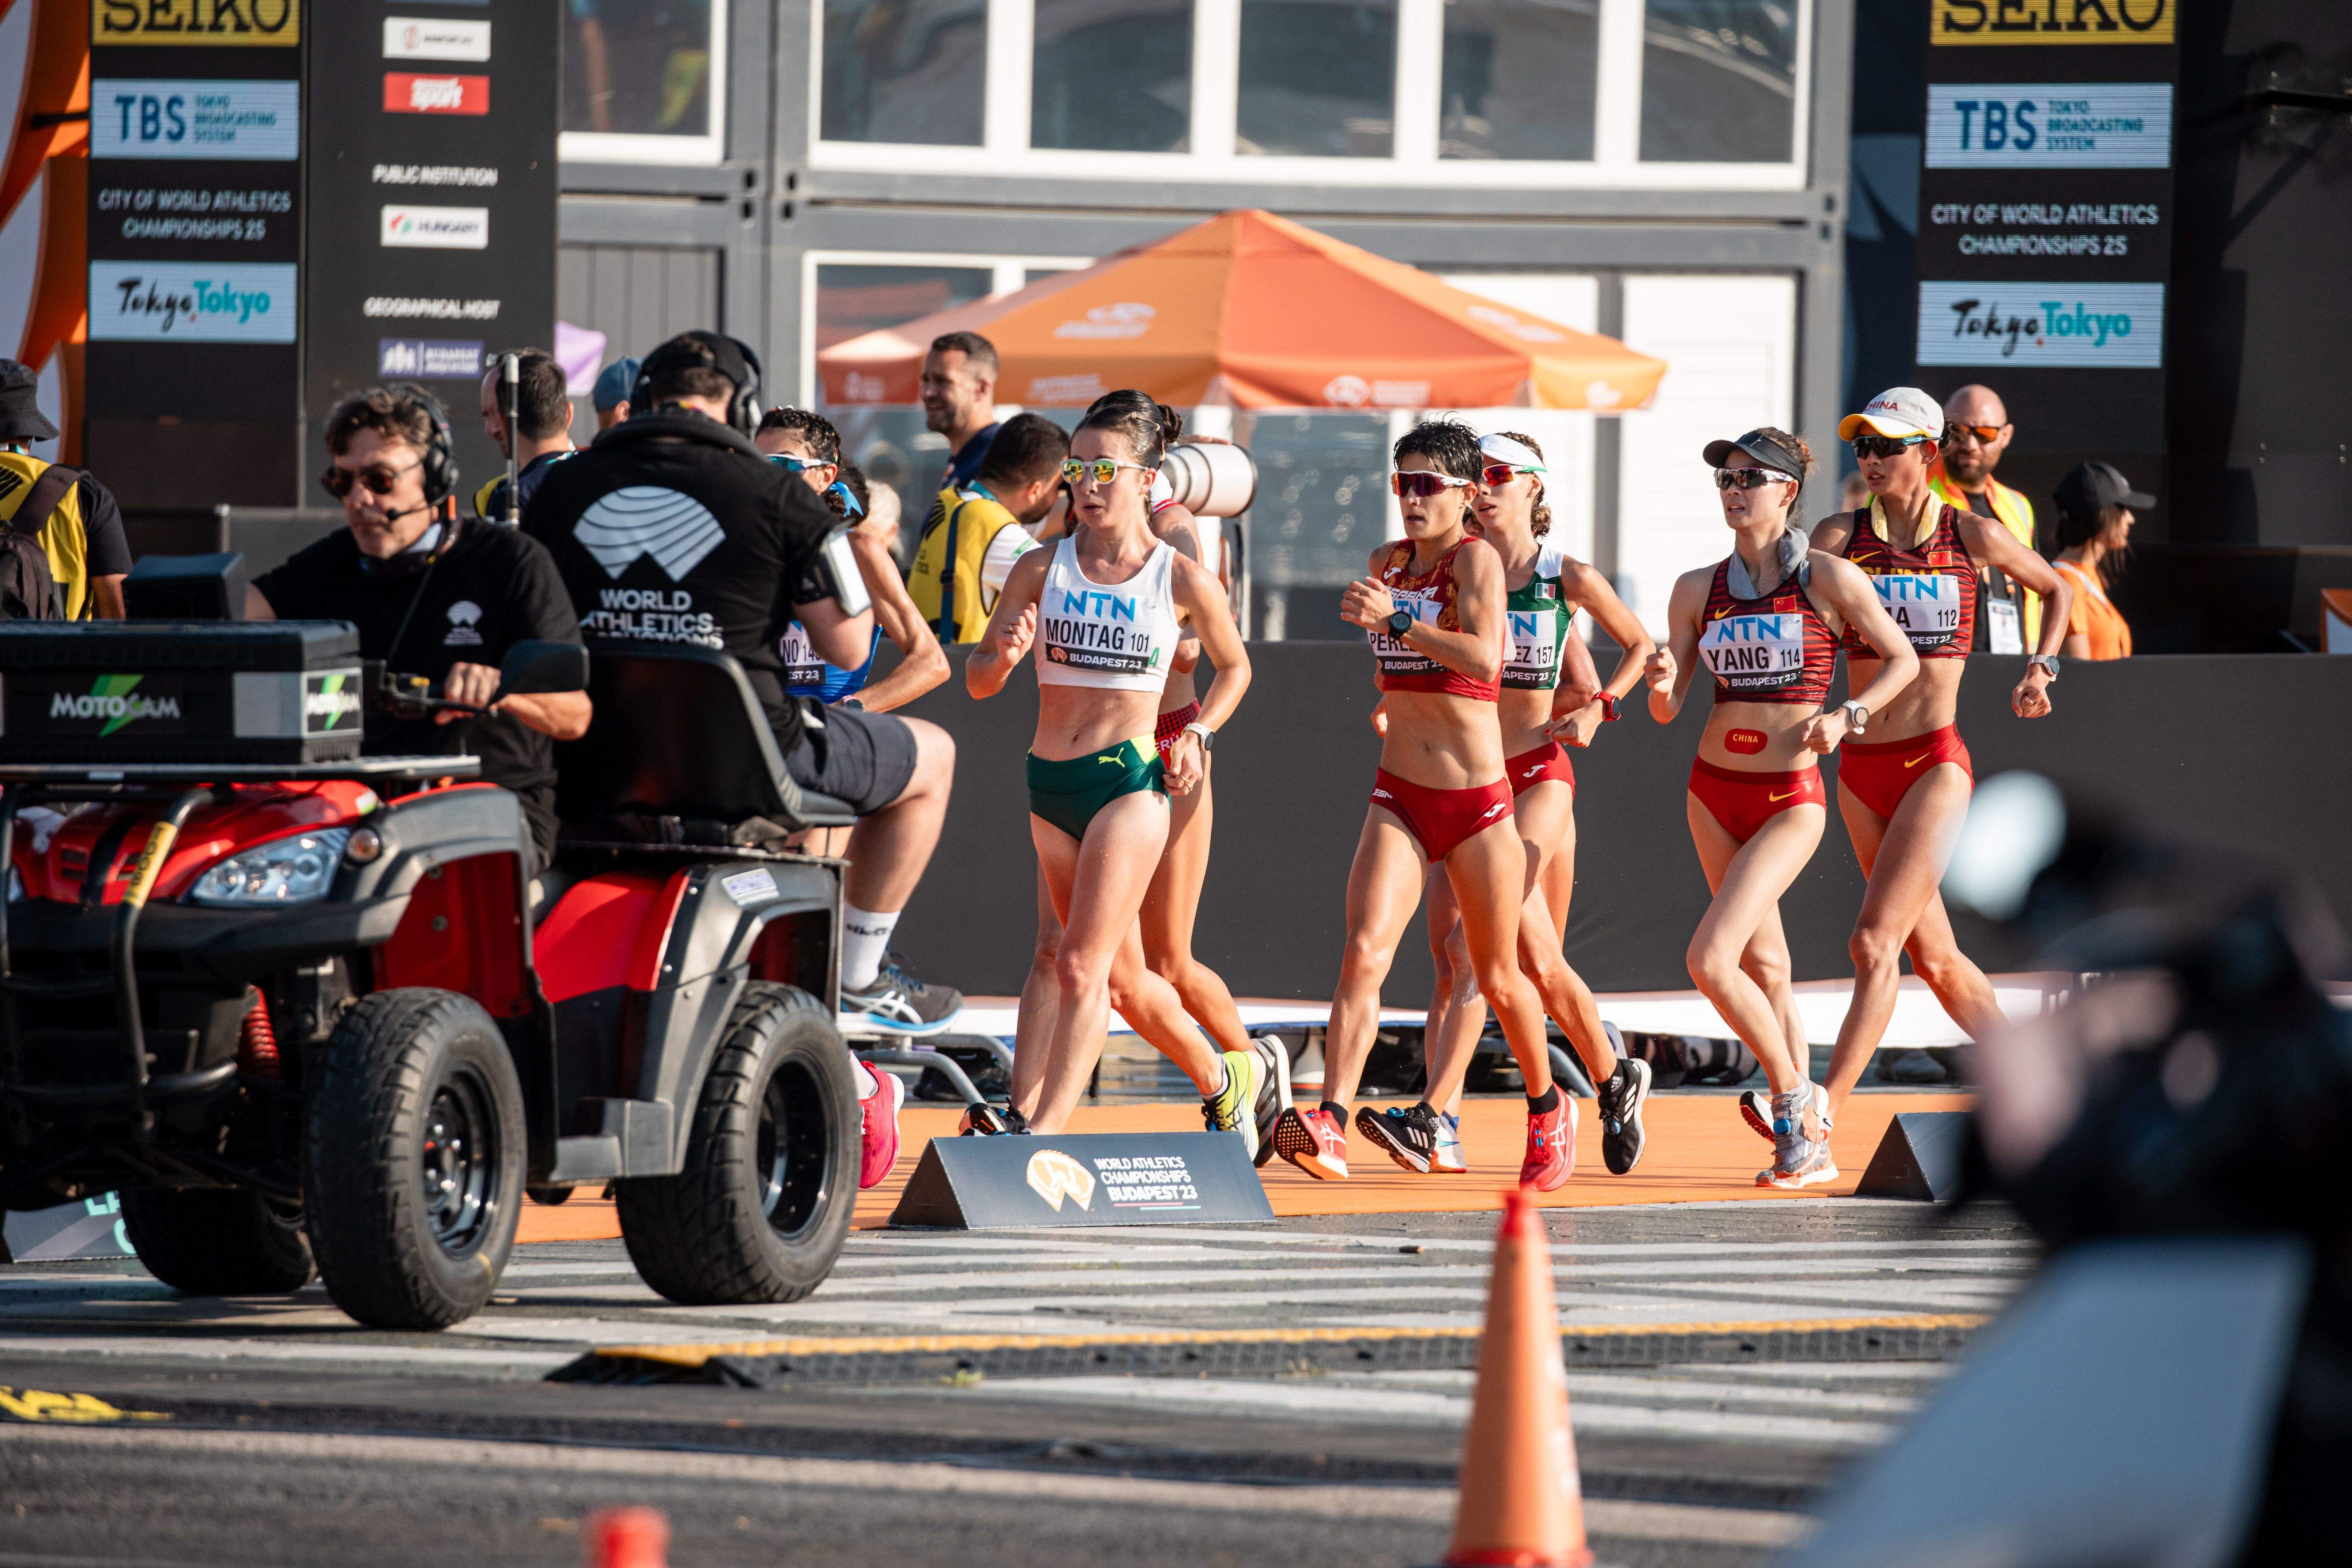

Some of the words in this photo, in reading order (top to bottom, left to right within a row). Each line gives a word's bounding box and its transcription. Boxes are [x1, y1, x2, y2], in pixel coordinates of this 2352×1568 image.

[104, 0, 292, 32] SEIKO
[1944, 0, 2166, 32] SEIKO
[2047, 101, 2090, 114] TOKYO
[115, 94, 186, 143] TBS
[1954, 100, 2037, 151] TBS
[2047, 119, 2143, 132] BROADCASTING
[2047, 137, 2096, 150] SYSTEM
[372, 164, 420, 184] PUBLIC
[421, 166, 498, 187] INSTITUTION
[97, 188, 132, 211] CITY
[133, 189, 156, 211] OF
[157, 189, 212, 212] WORLD
[212, 190, 292, 212] ATHLETICS
[1931, 204, 1971, 224] CITY
[1973, 204, 1998, 224] OF
[2000, 204, 2065, 225] WORLD
[2066, 204, 2159, 225] ATHLETICS
[121, 216, 244, 240] CHAMPIONSHIPS
[244, 218, 267, 241] 25
[1958, 235, 2101, 255] CHAMPIONSHIPS
[2103, 235, 2128, 255] 25
[193, 279, 271, 324] Tokyo
[363, 297, 461, 319] GEOGRAPHICAL
[462, 299, 501, 320] HOST
[2040, 301, 2132, 348] Tokyo
[1864, 400, 1898, 412] CHINA
[599, 589, 692, 612] WORLD
[1064, 589, 1136, 622] NTN
[579, 610, 715, 635] ATHLETICS
[1938, 609, 1957, 627] 112
[1045, 618, 1125, 651] MONTAG
[1130, 632, 1150, 653] 101
[1718, 615, 1781, 644] NTN
[1939, 635, 1951, 644] 23
[1070, 653, 1128, 669] BUDAPEST
[1128, 660, 1142, 669] 23
[1536, 646, 1553, 664] 157
[1707, 646, 1770, 671] YANG
[1780, 648, 1801, 667] 114
[805, 669, 819, 679] 23
[1384, 661, 1429, 670] BUDAPEST
[1538, 671, 1549, 681] 23
[1731, 675, 1784, 687] BUDAPEST
[1784, 672, 1797, 683] 23
[1732, 733, 1759, 743] CHINA
[1093, 1157, 1131, 1170] WORLD
[1132, 1156, 1185, 1170] ATHLETICS
[1100, 1170, 1192, 1185] CHAMPIONSHIPS
[1106, 1186, 1180, 1201] BUDAPEST
